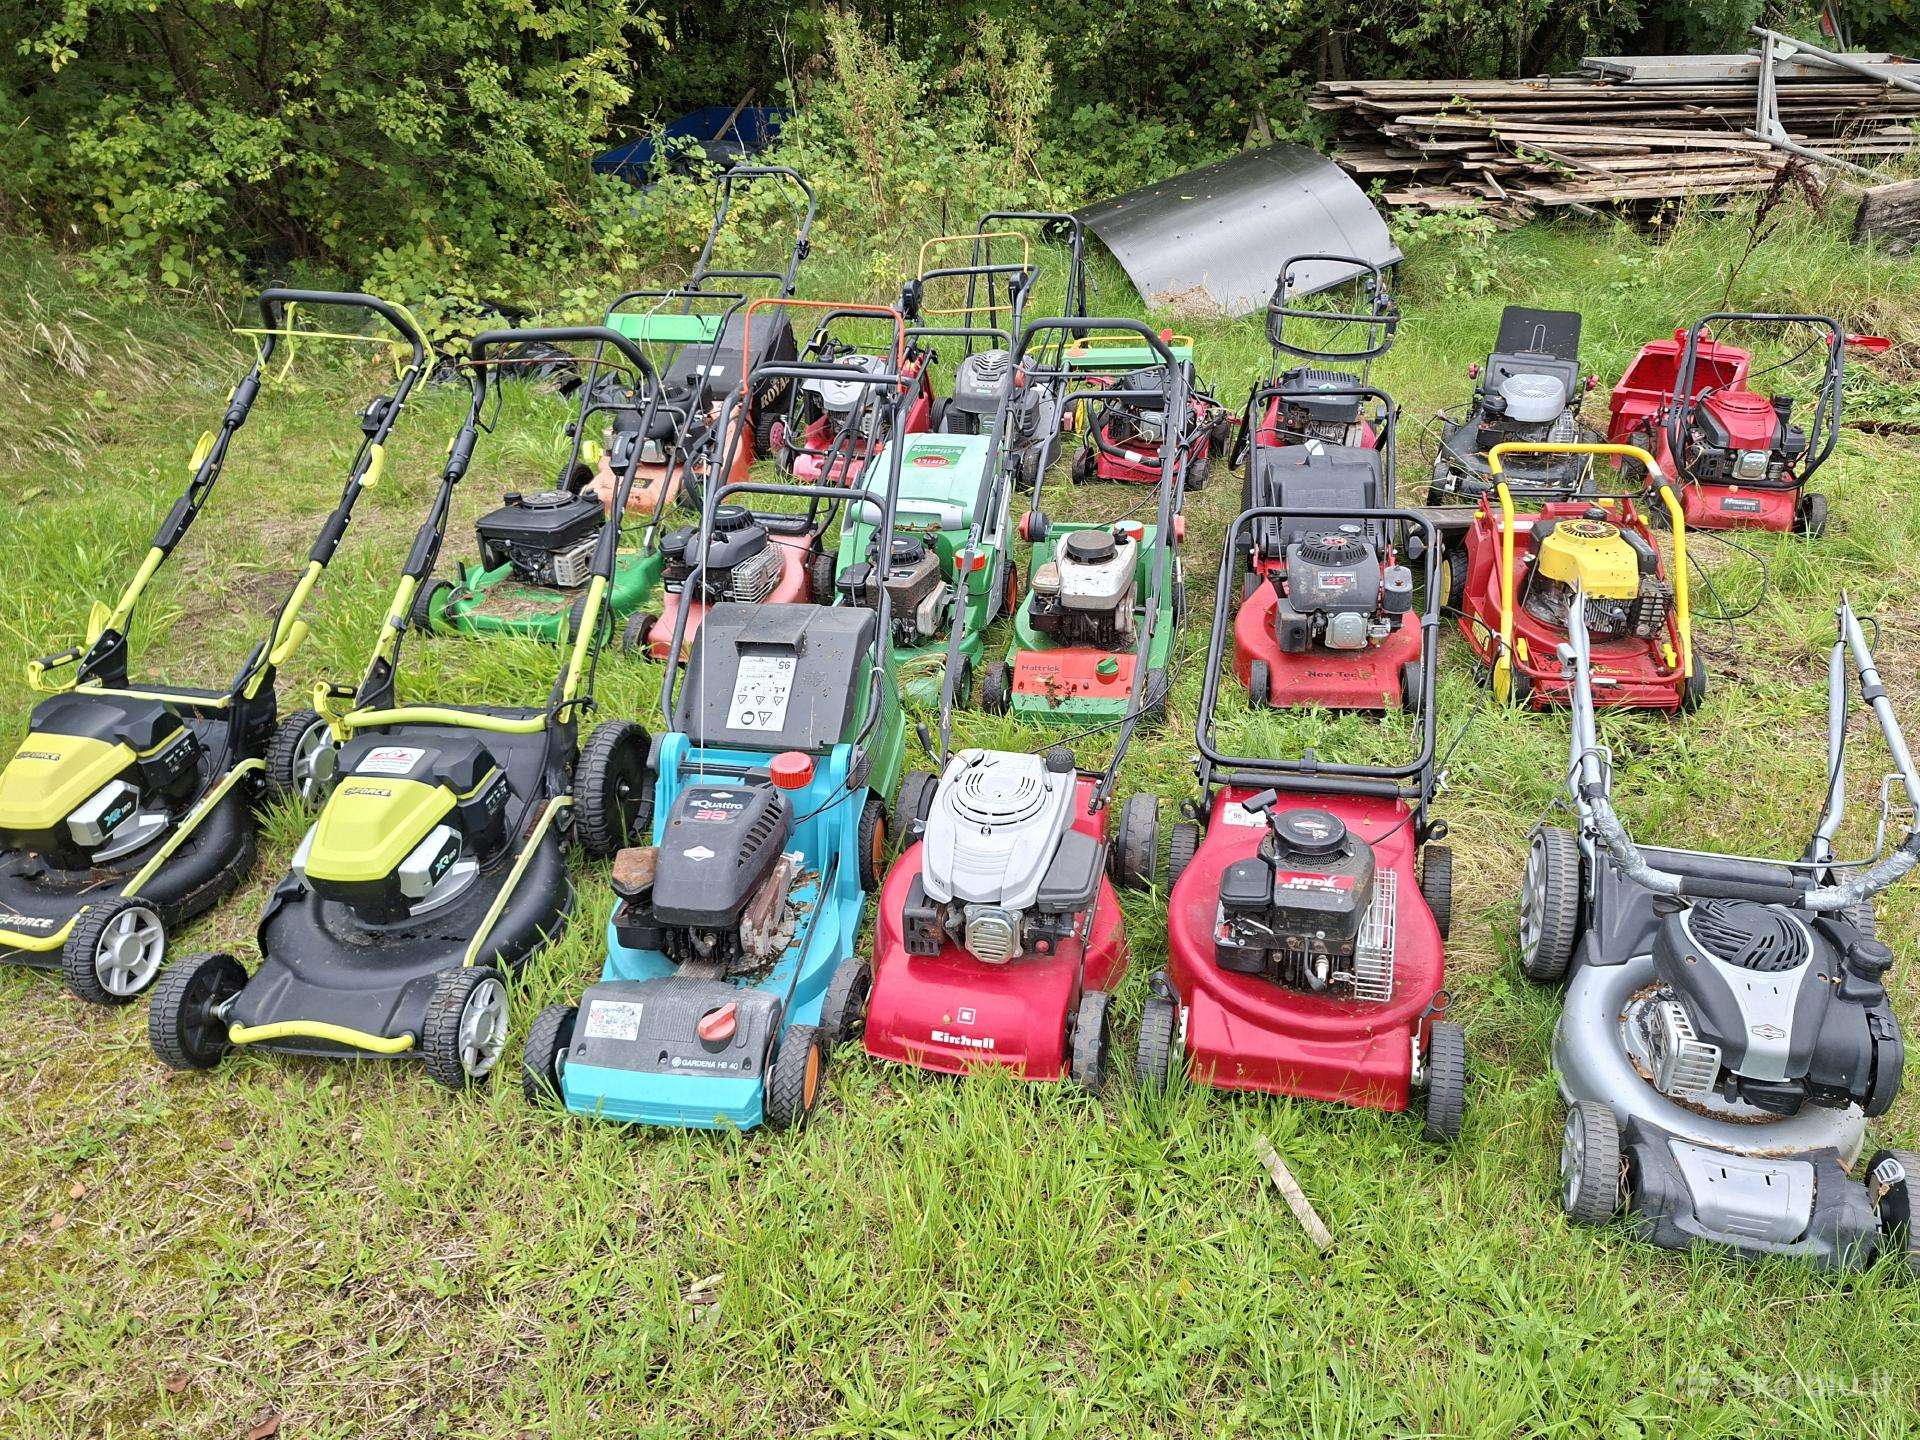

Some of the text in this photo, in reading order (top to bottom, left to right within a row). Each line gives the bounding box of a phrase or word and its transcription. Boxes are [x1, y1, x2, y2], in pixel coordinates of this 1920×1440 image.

[694, 809, 727, 820] 38
[1291, 877, 1325, 888] MTD
[931, 1030, 995, 1049] Einhell
[682, 1060, 715, 1069] GARDENA
[729, 1062, 739, 1070] 40
